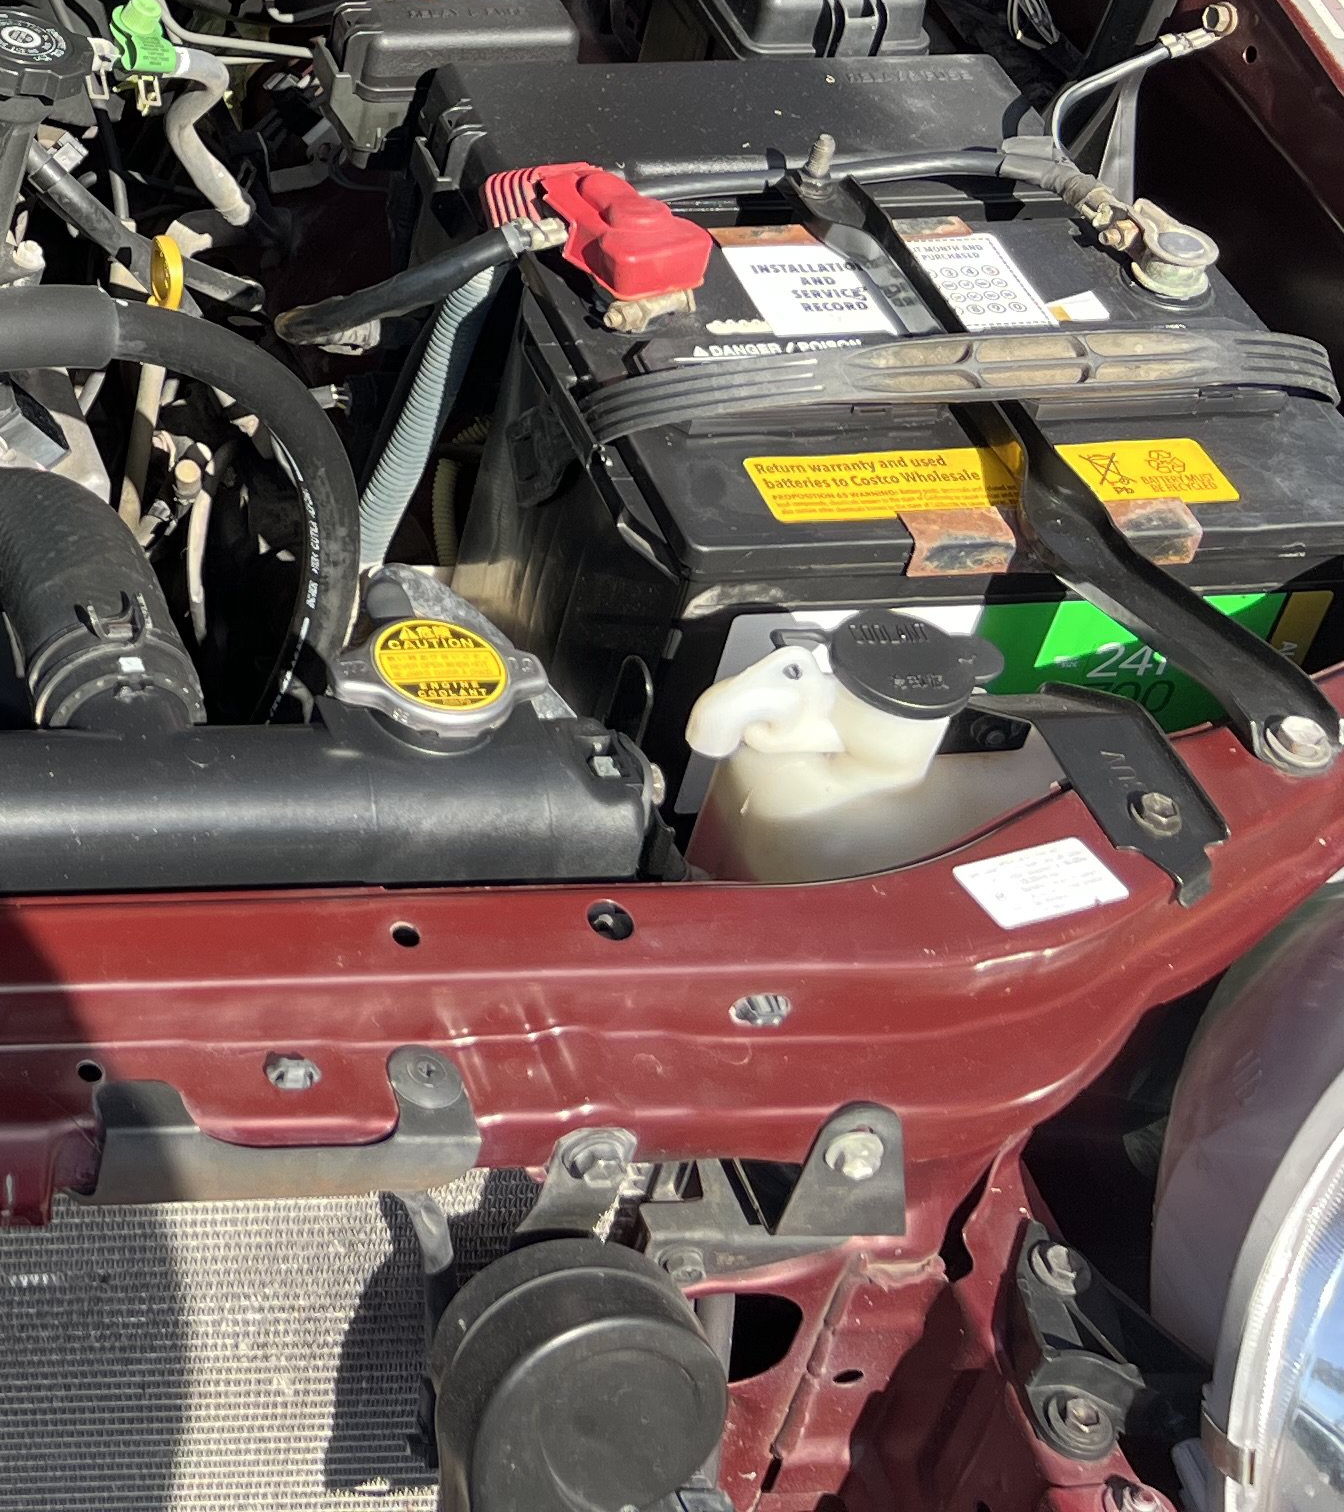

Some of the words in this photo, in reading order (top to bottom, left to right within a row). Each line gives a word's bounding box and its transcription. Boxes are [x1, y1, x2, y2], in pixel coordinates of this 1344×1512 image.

[924, 244, 960, 253] MONTH
[962, 244, 984, 252] AND
[800, 276, 836, 287] AND
[800, 301, 869, 313] RECORD
[708, 343, 783, 357] DANGER
[754, 462, 806, 475] Return
[808, 459, 876, 475] warranty
[879, 456, 911, 469] and
[912, 454, 947, 467] used
[762, 476, 830, 490] batteries
[832, 476, 849, 489] to
[850, 474, 900, 488] Costco
[902, 469, 982, 484] Wholesale
[1140, 474, 1184, 485] BATTERY
[1184, 472, 1216, 483] MUST
[1113, 486, 1135, 494] Pb
[1150, 484, 1166, 493] BE
[1167, 482, 1219, 492] RECYCLED
[772, 492, 835, 501] PROPOSITION
[387, 637, 476, 651] CAUTION
[416, 688, 488, 699] COOLANT
